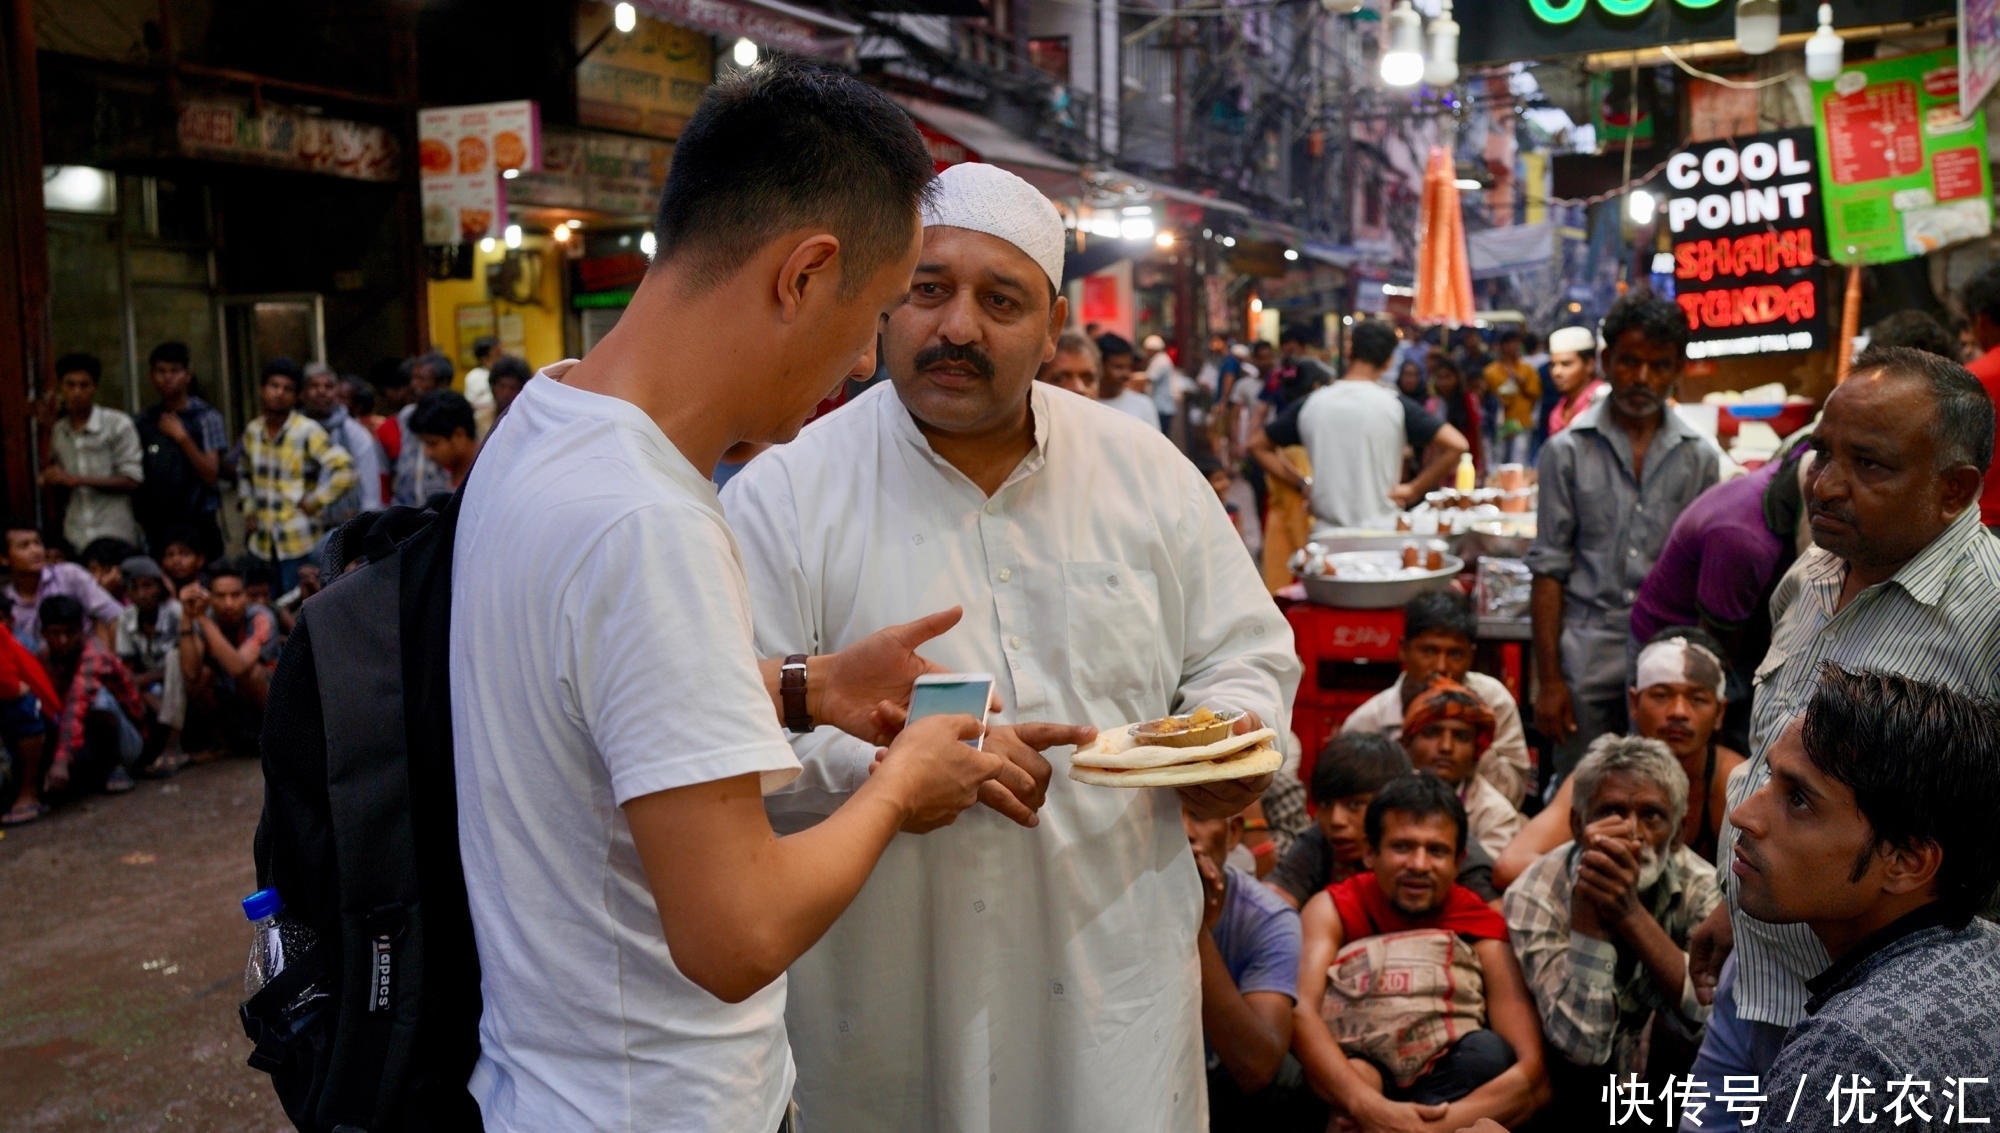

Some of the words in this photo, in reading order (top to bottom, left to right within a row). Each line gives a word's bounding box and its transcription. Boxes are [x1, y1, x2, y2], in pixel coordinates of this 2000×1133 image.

[1666, 138, 1810, 190] COOL
[1668, 182, 1812, 233] POINT
[1674, 228, 1814, 282] SHAHI
